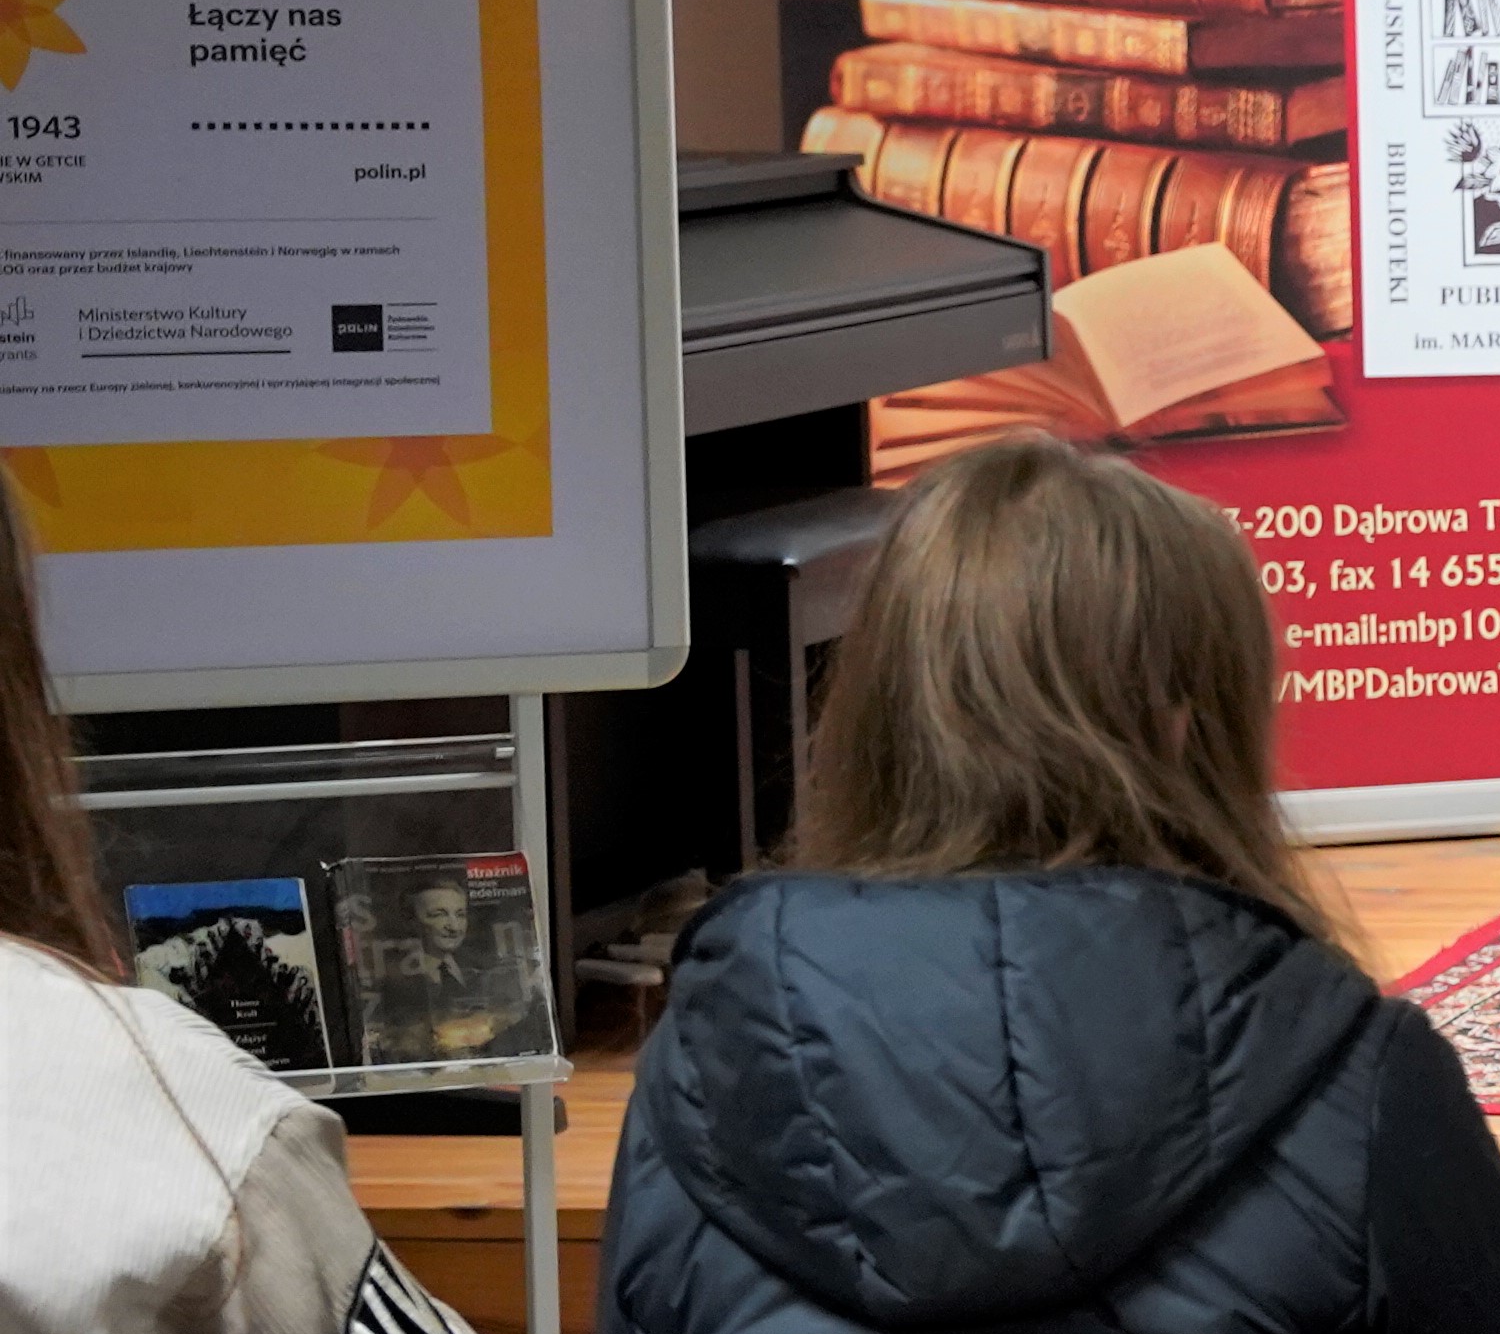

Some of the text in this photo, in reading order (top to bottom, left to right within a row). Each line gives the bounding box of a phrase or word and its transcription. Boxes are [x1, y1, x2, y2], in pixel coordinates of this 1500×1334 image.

[188, 3, 342, 32] Łączy nas
[190, 37, 307, 67] pamięć
[7, 114, 82, 139] 1943
[16, 155, 31, 167] W
[36, 155, 87, 168] GETCIE
[355, 163, 426, 183] polin.pl
[1387, 141, 1409, 305] BIBLIOTEKI
[5, 248, 86, 261] finansowany
[89, 249, 124, 261] przez
[183, 244, 267, 259] Liechtenstein
[341, 246, 351, 255] w
[354, 244, 400, 256] ramach
[28, 265, 56, 275] oraz
[59, 264, 95, 277] przez
[144, 261, 194, 275] krajowy
[78, 305, 248, 324] Ministerstwo Kultury
[88, 324, 187, 342] Dziedzictwa
[191, 323, 294, 341] Narodowego
[1414, 332, 1444, 351] im.
[1221, 504, 1324, 540] 3-200
[1333, 501, 1469, 544] Dąbrowa
[1330, 558, 1376, 593] fax
[1391, 556, 1431, 590] 14
